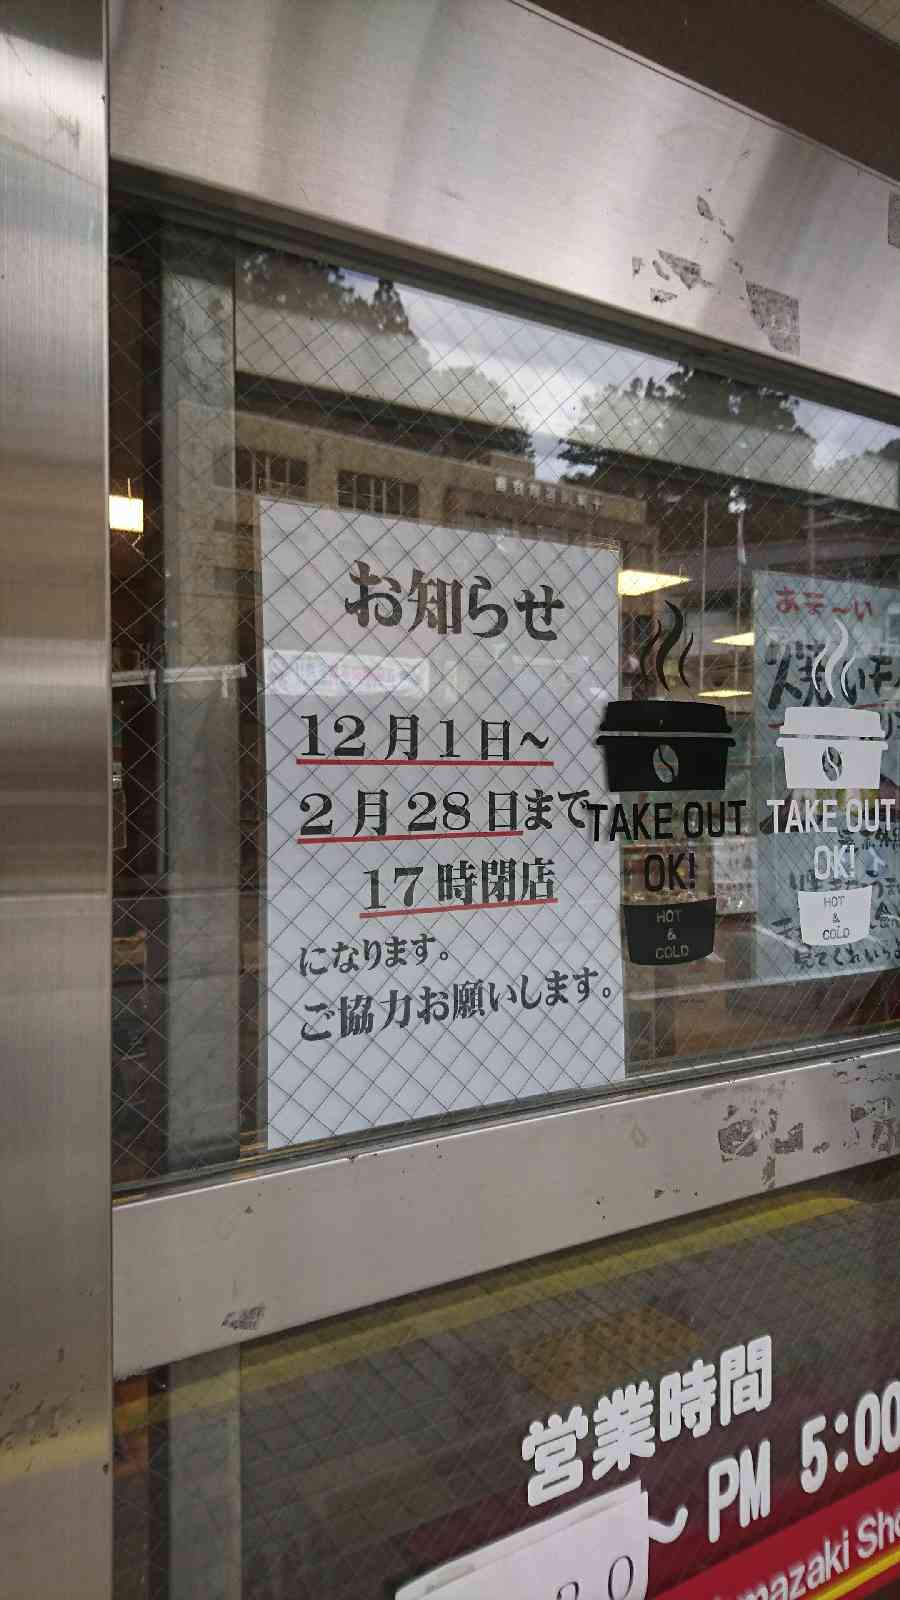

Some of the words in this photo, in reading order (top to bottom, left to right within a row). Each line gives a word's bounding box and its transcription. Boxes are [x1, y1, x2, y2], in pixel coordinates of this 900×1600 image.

[344, 559, 566, 642] お知らせ
[299, 788, 590, 837] 2月28日まで
[587, 802, 673, 842] TAKE
[683, 800, 746, 838] OUT
[766, 799, 838, 834] TAKE
[845, 798, 896, 833] OUT
[644, 852, 696, 892] OK!
[813, 843, 855, 881] OK!
[363, 857, 556, 910] 17時閉店
[823, 895, 846, 908] HOT
[655, 908, 682, 923] HOT
[822, 927, 850, 940] COLD
[832, 912, 841, 923] &
[299, 932, 449, 977] になります。
[655, 944, 689, 959] COLD
[666, 931, 677, 941] &
[300, 966, 612, 1042] ご協力お願いします。
[521, 1335, 773, 1507] 営業時間
[708, 1438, 771, 1544] PM
[801, 1380, 900, 1494] 5:00
